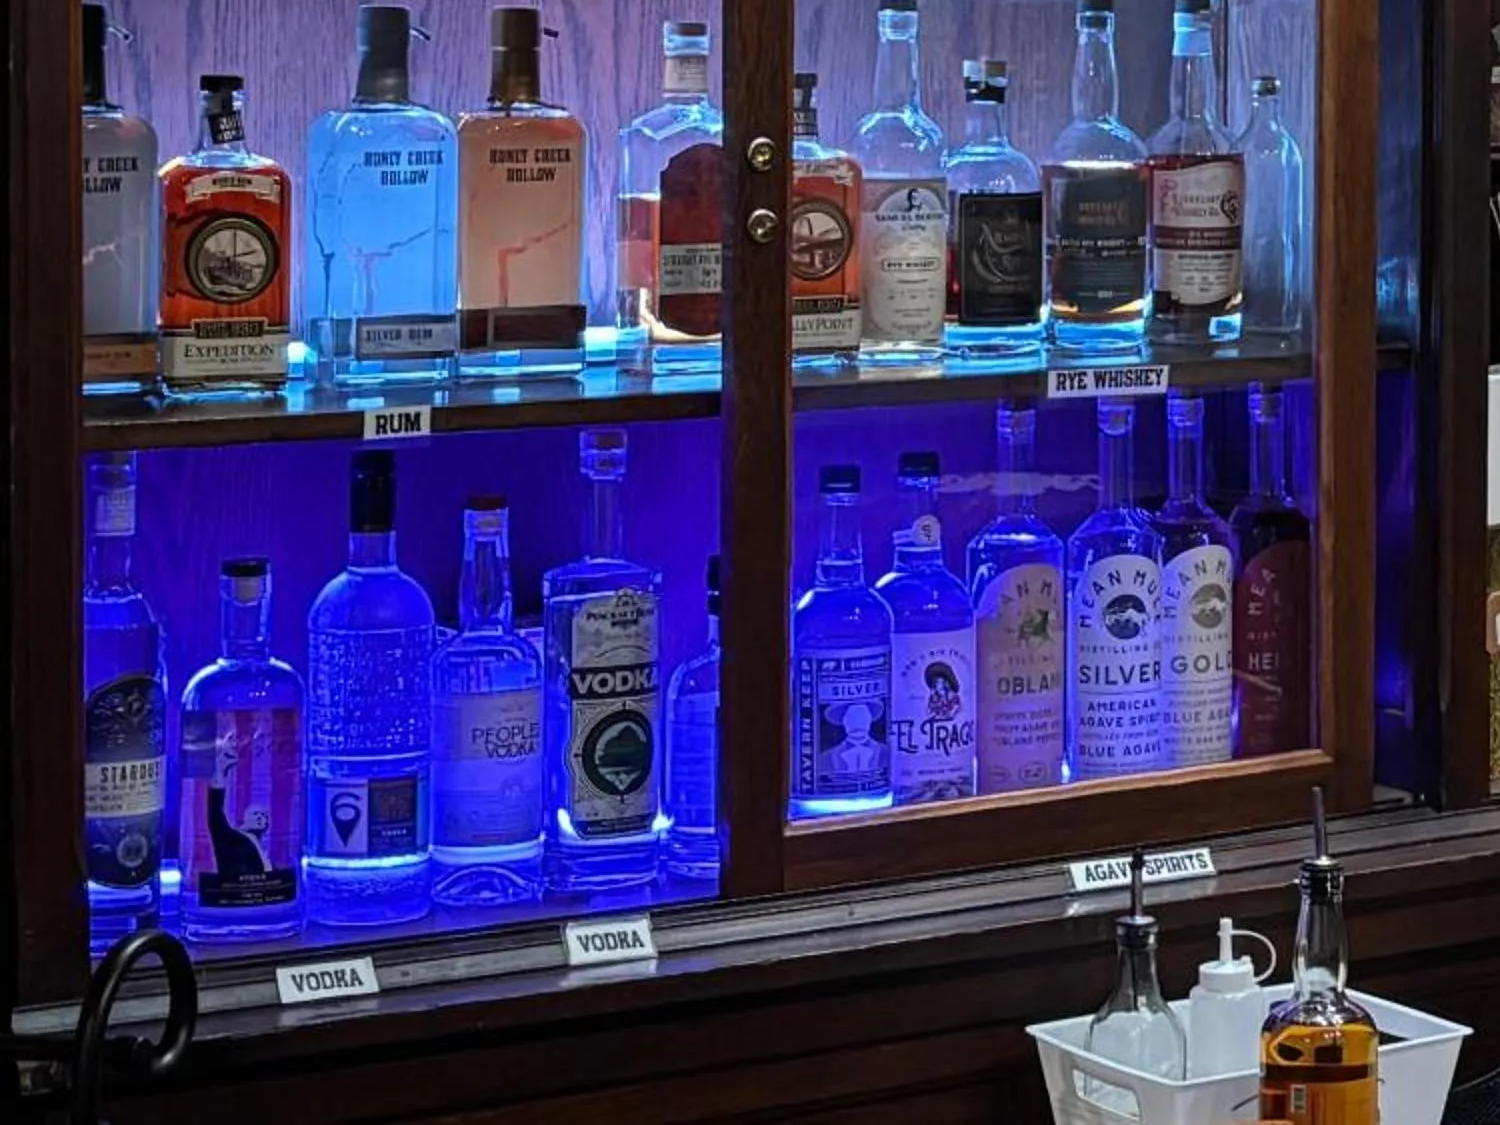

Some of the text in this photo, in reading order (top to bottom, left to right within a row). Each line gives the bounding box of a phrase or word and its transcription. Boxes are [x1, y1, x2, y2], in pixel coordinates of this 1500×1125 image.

[97, 156, 140, 173] CREEK
[489, 147, 572, 165] HONEY CREEK
[184, 343, 275, 359] EXPEDITION
[1055, 367, 1166, 392] RYE WHISKEY
[374, 411, 422, 435] RUM
[1078, 660, 1161, 686] SILVER
[1084, 853, 1208, 883] AGAV SPIRITS
[576, 928, 645, 955] VODKA
[290, 967, 365, 993] VODKA
